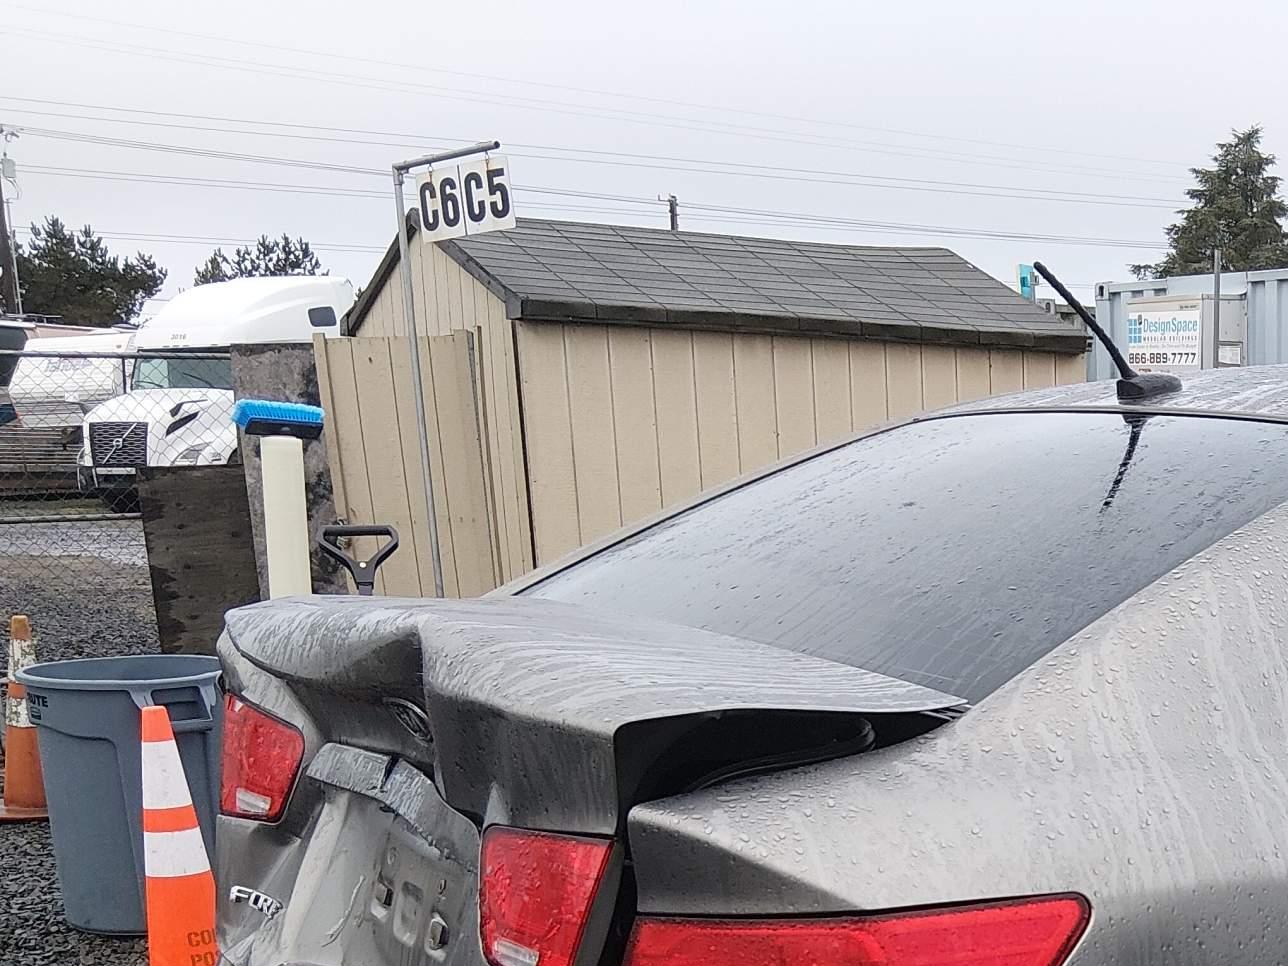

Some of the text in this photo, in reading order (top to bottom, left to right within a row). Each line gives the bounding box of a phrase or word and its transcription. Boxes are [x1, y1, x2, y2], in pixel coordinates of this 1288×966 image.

[419, 167, 511, 232] C6 C5
[1143, 318, 1198, 336] DesignSpace
